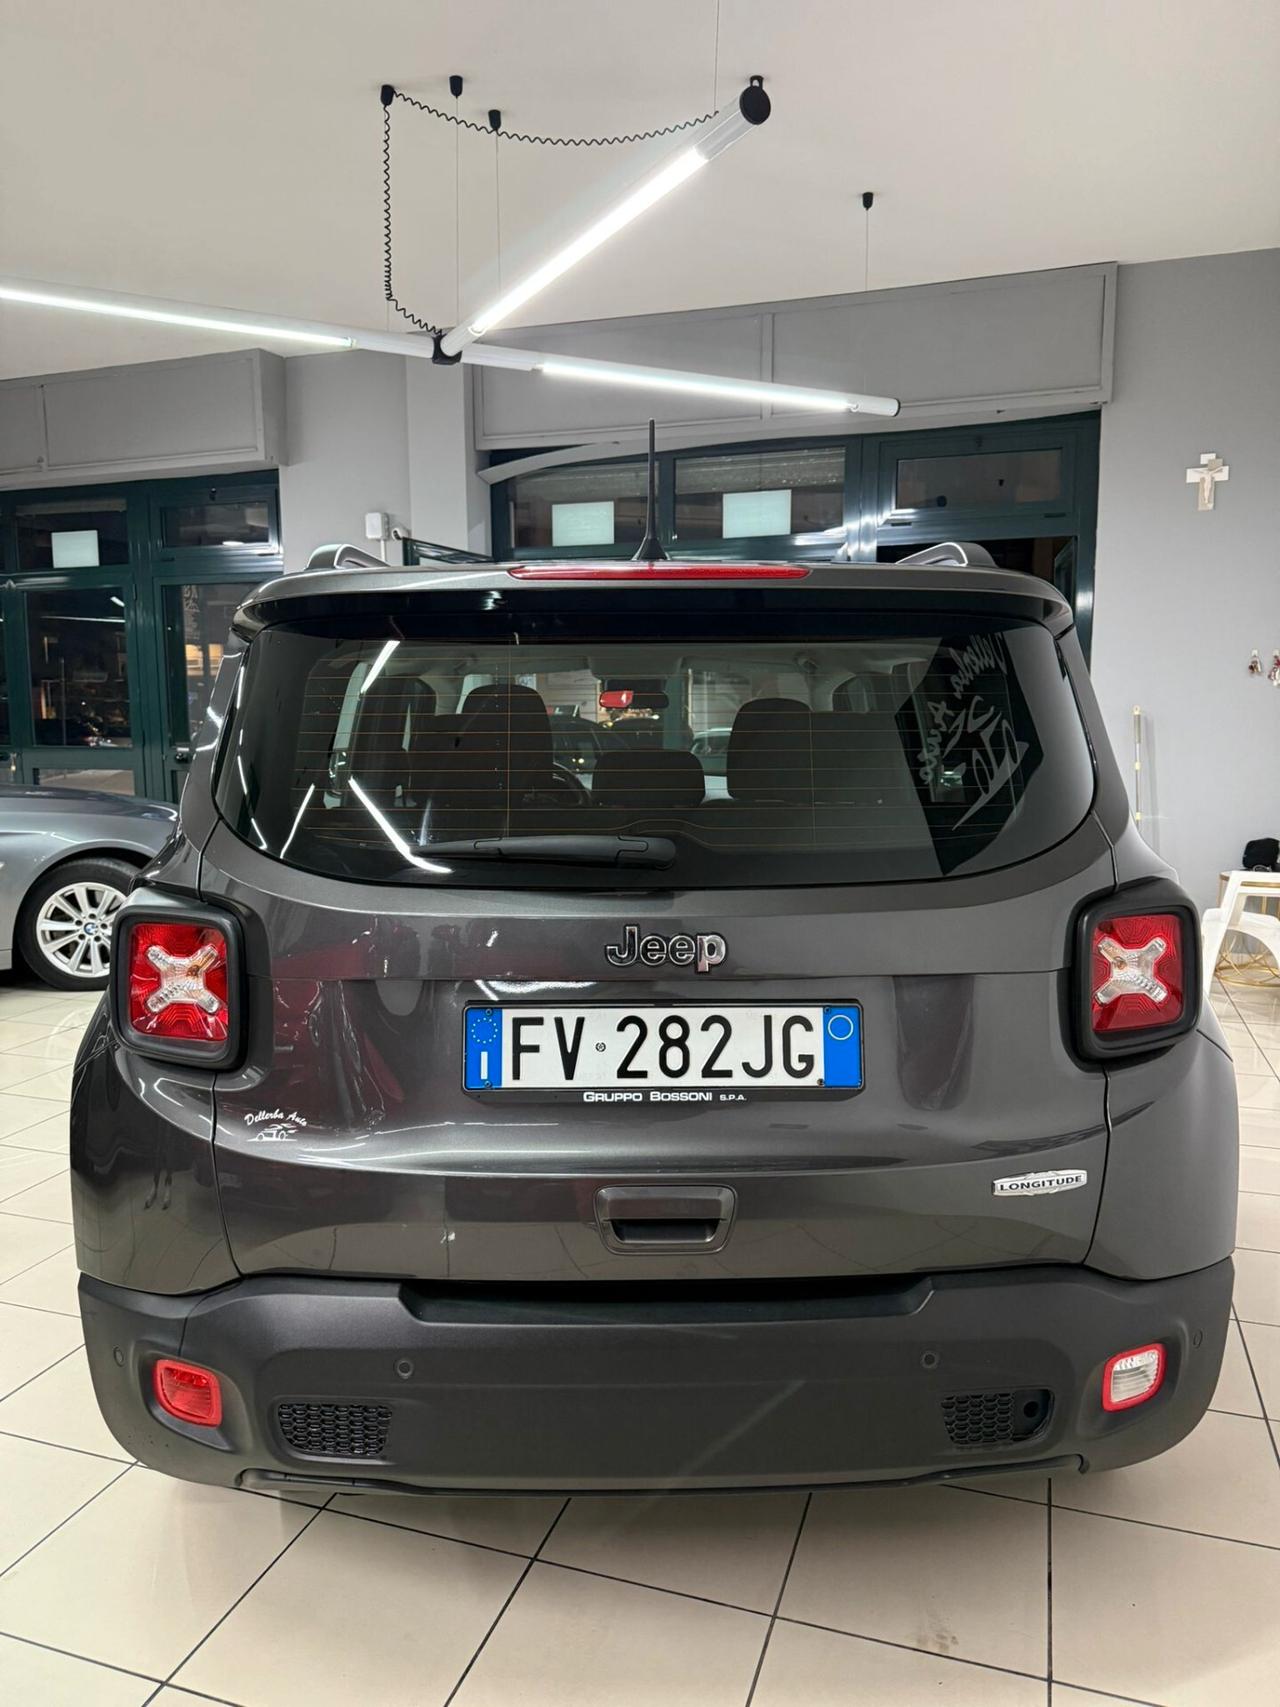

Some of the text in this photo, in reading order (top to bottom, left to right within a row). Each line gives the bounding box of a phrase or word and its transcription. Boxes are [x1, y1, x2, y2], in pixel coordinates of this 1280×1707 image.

[606, 925, 728, 974] Jeep
[512, 1015, 815, 1081] FV 282JG
[480, 1051, 489, 1080] I
[583, 1091, 643, 1102] GRUPPO
[650, 1091, 713, 1102] BOSSONI
[286, 1111, 308, 1127] Auto
[1000, 1175, 1082, 1191] LONGITUDE
